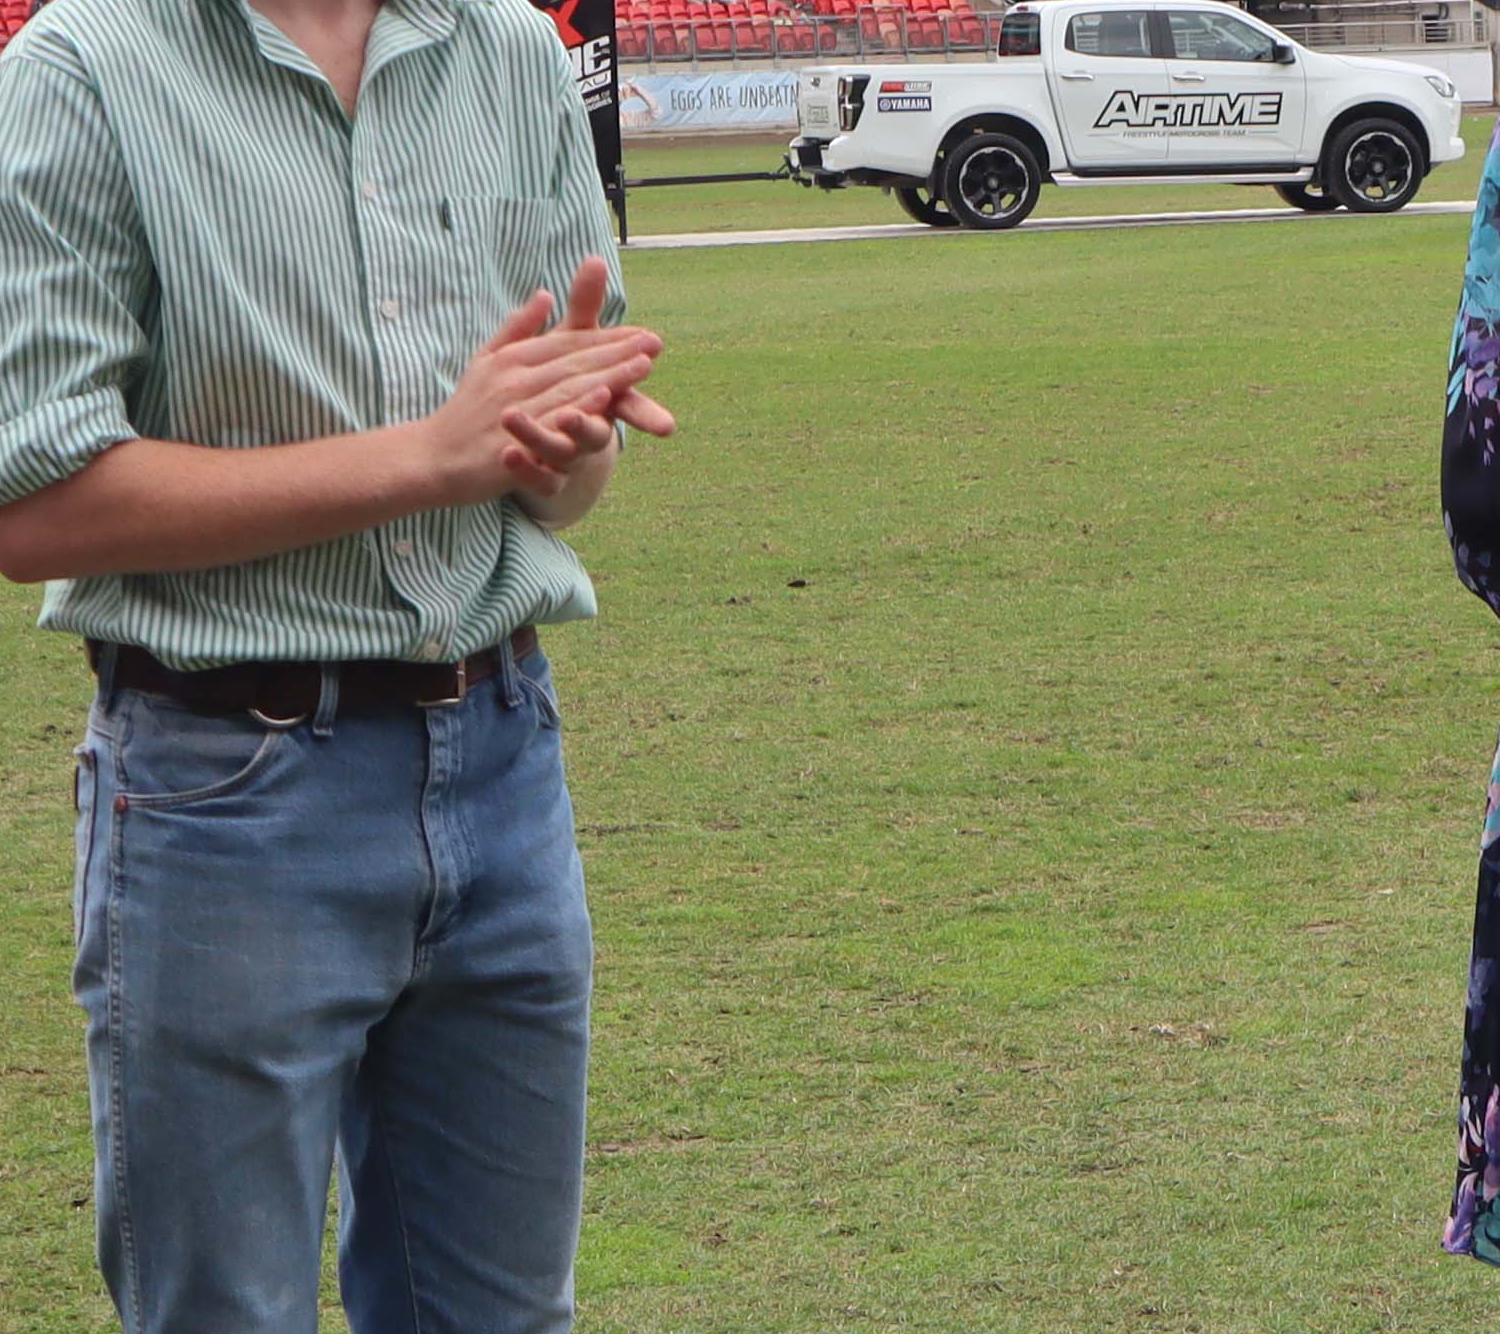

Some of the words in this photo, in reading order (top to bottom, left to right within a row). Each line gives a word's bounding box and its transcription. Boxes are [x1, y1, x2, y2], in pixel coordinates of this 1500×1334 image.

[670, 87, 702, 112] EGGS
[709, 83, 733, 110] ARE
[739, 78, 799, 109] UNBEATA
[891, 98, 931, 111] YAMAHA
[1093, 90, 1283, 129] AIRTIME
[1223, 128, 1247, 137] TEAM
